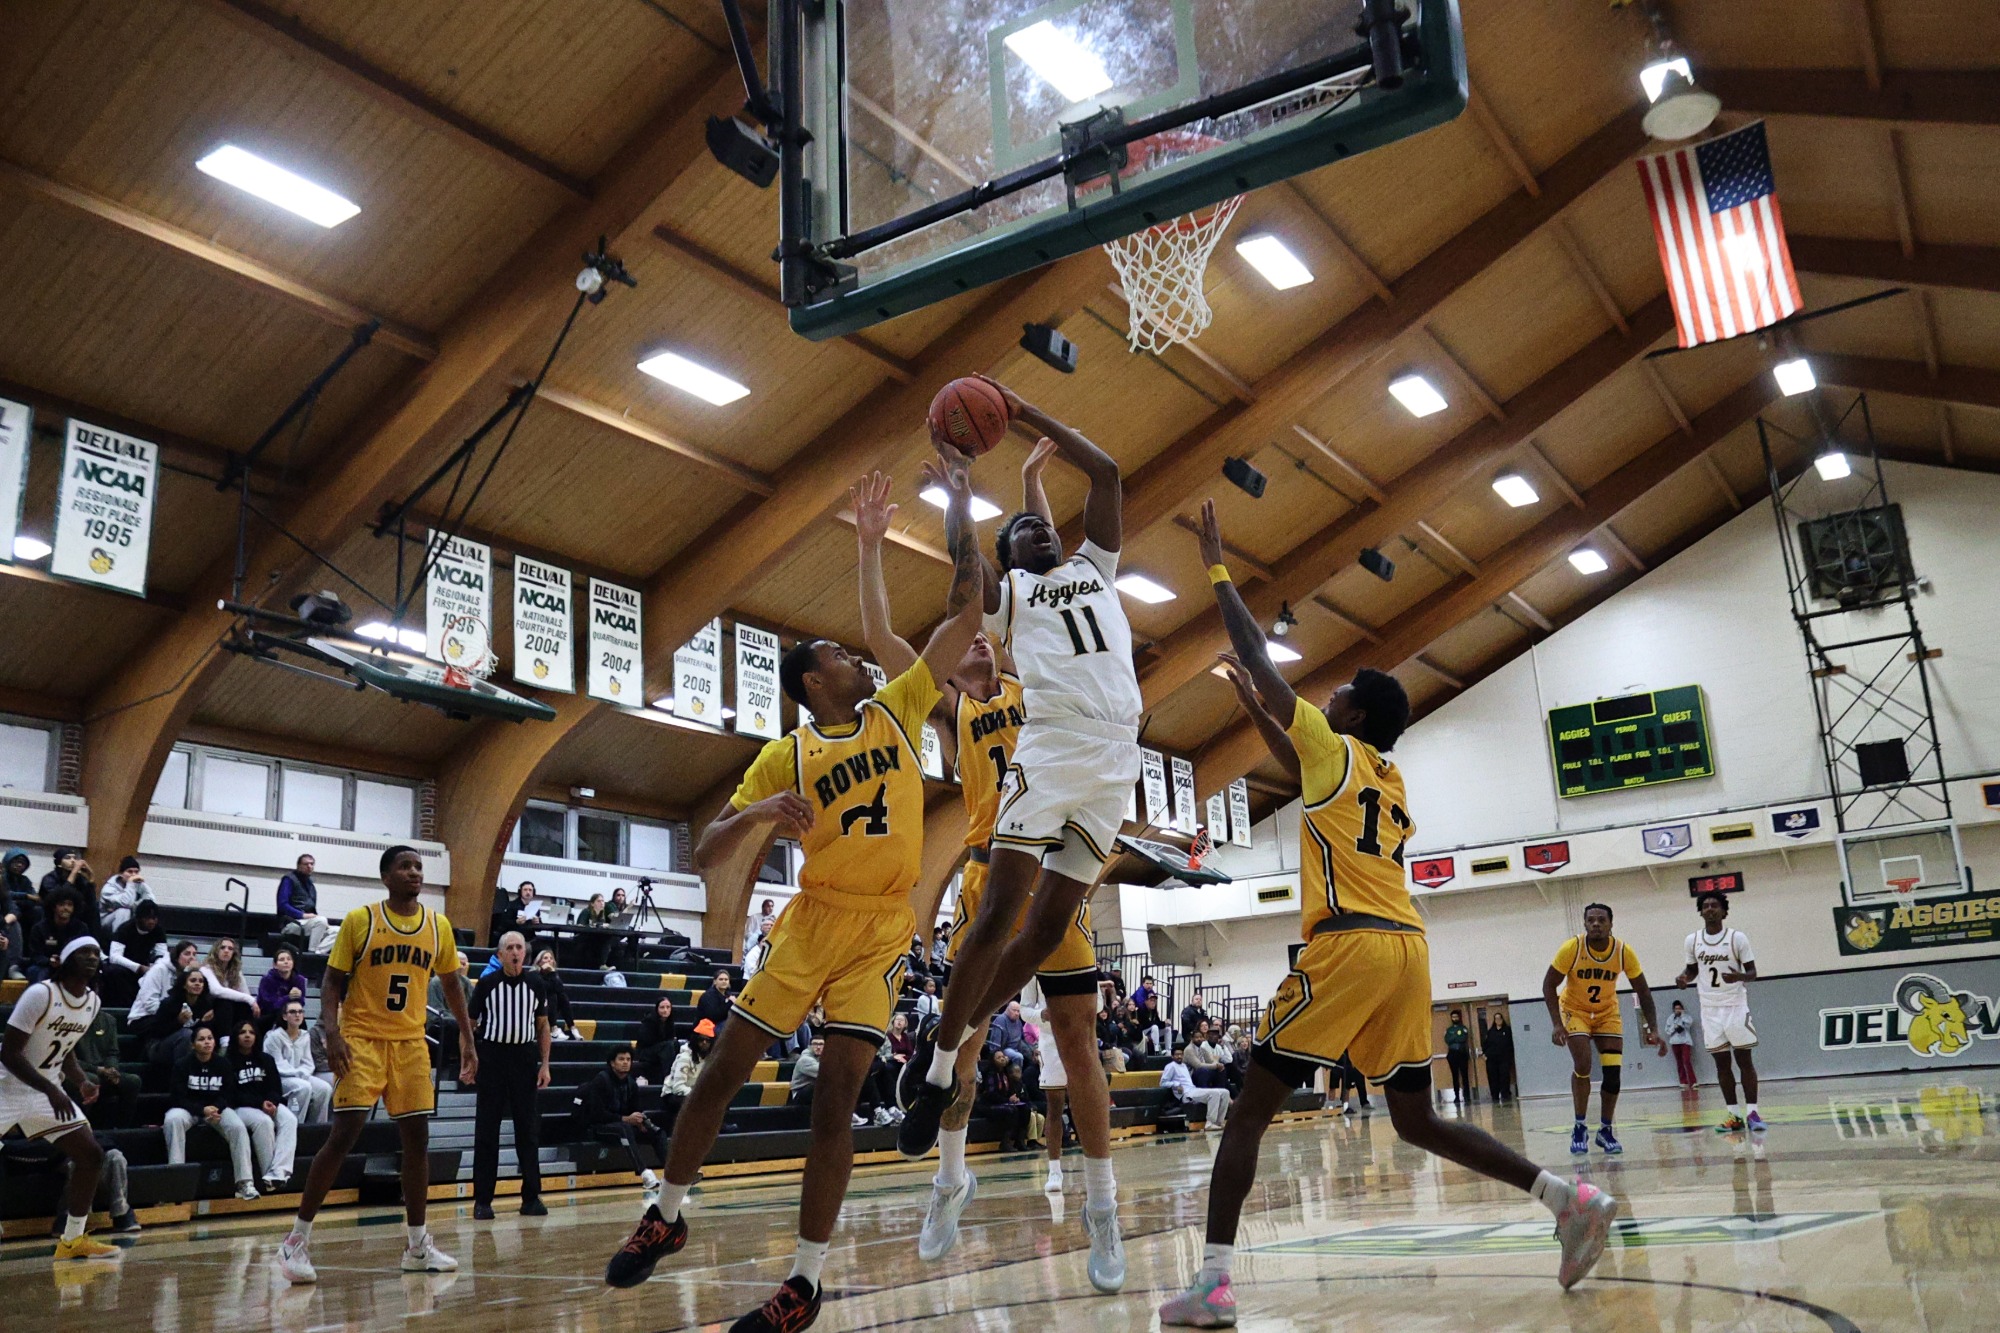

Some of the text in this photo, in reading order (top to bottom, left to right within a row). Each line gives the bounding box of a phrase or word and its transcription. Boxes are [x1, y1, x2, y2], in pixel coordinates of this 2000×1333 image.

[77, 427, 150, 462] DELVAL
[73, 458, 146, 497] NCAA
[76, 487, 139, 513] REGIONALS
[71, 500, 142, 528] FIRST PLACE
[84, 518, 133, 547] 1995
[435, 539, 485, 563] ELVAL
[433, 562, 483, 592] NCAA
[520, 562, 566, 587] DELVAL
[436, 585, 480, 606] REGIONALS
[519, 587, 566, 615] NCAA
[594, 583, 638, 608] DELVAL
[1027, 579, 1104, 608] Aggies
[433, 597, 481, 618] FIRST PLACE
[442, 612, 475, 635] 1996
[516, 619, 568, 641] FOURTH PLACE
[522, 610, 563, 628] NATIONALS
[595, 608, 637, 634] NCAA
[593, 631, 639, 651] QUARTERFINALS
[740, 628, 776, 649] DELVAL
[1059, 605, 1110, 656] 11
[524, 634, 560, 656] 2004
[602, 652, 632, 674] 2004
[675, 654, 717, 673] QUARTERFINALS
[740, 651, 775, 674] NCAA
[683, 674, 712, 695] 2005
[742, 680, 775, 696] FIRST PLACE
[743, 670, 773, 686] REGIONALS
[748, 691, 772, 710] 2007
[970, 704, 1024, 744] ROWA
[1662, 710, 1692, 724] GUEST
[1560, 728, 1590, 741] AGGIES
[1615, 725, 1637, 734] PERIOD
[921, 739, 934, 753] 019
[1610, 751, 1652, 762] PLAYER FOUL
[1680, 742, 1700, 751] FOULS
[1145, 766, 1162, 781] NCAA
[1563, 762, 1582, 770] FOULS
[1566, 786, 1586, 794] SCORE
[840, 782, 888, 835] 4
[1889, 897, 2000, 929] AGGIES
[371, 944, 431, 971] ROWAN
[1698, 951, 1729, 965] Aggies
[1709, 967, 1720, 987] 2
[387, 974, 410, 1012] 5
[1587, 986, 1601, 1003] 2
[47, 1016, 88, 1037] Aggies
[1824, 1008, 1908, 1047] DEL
